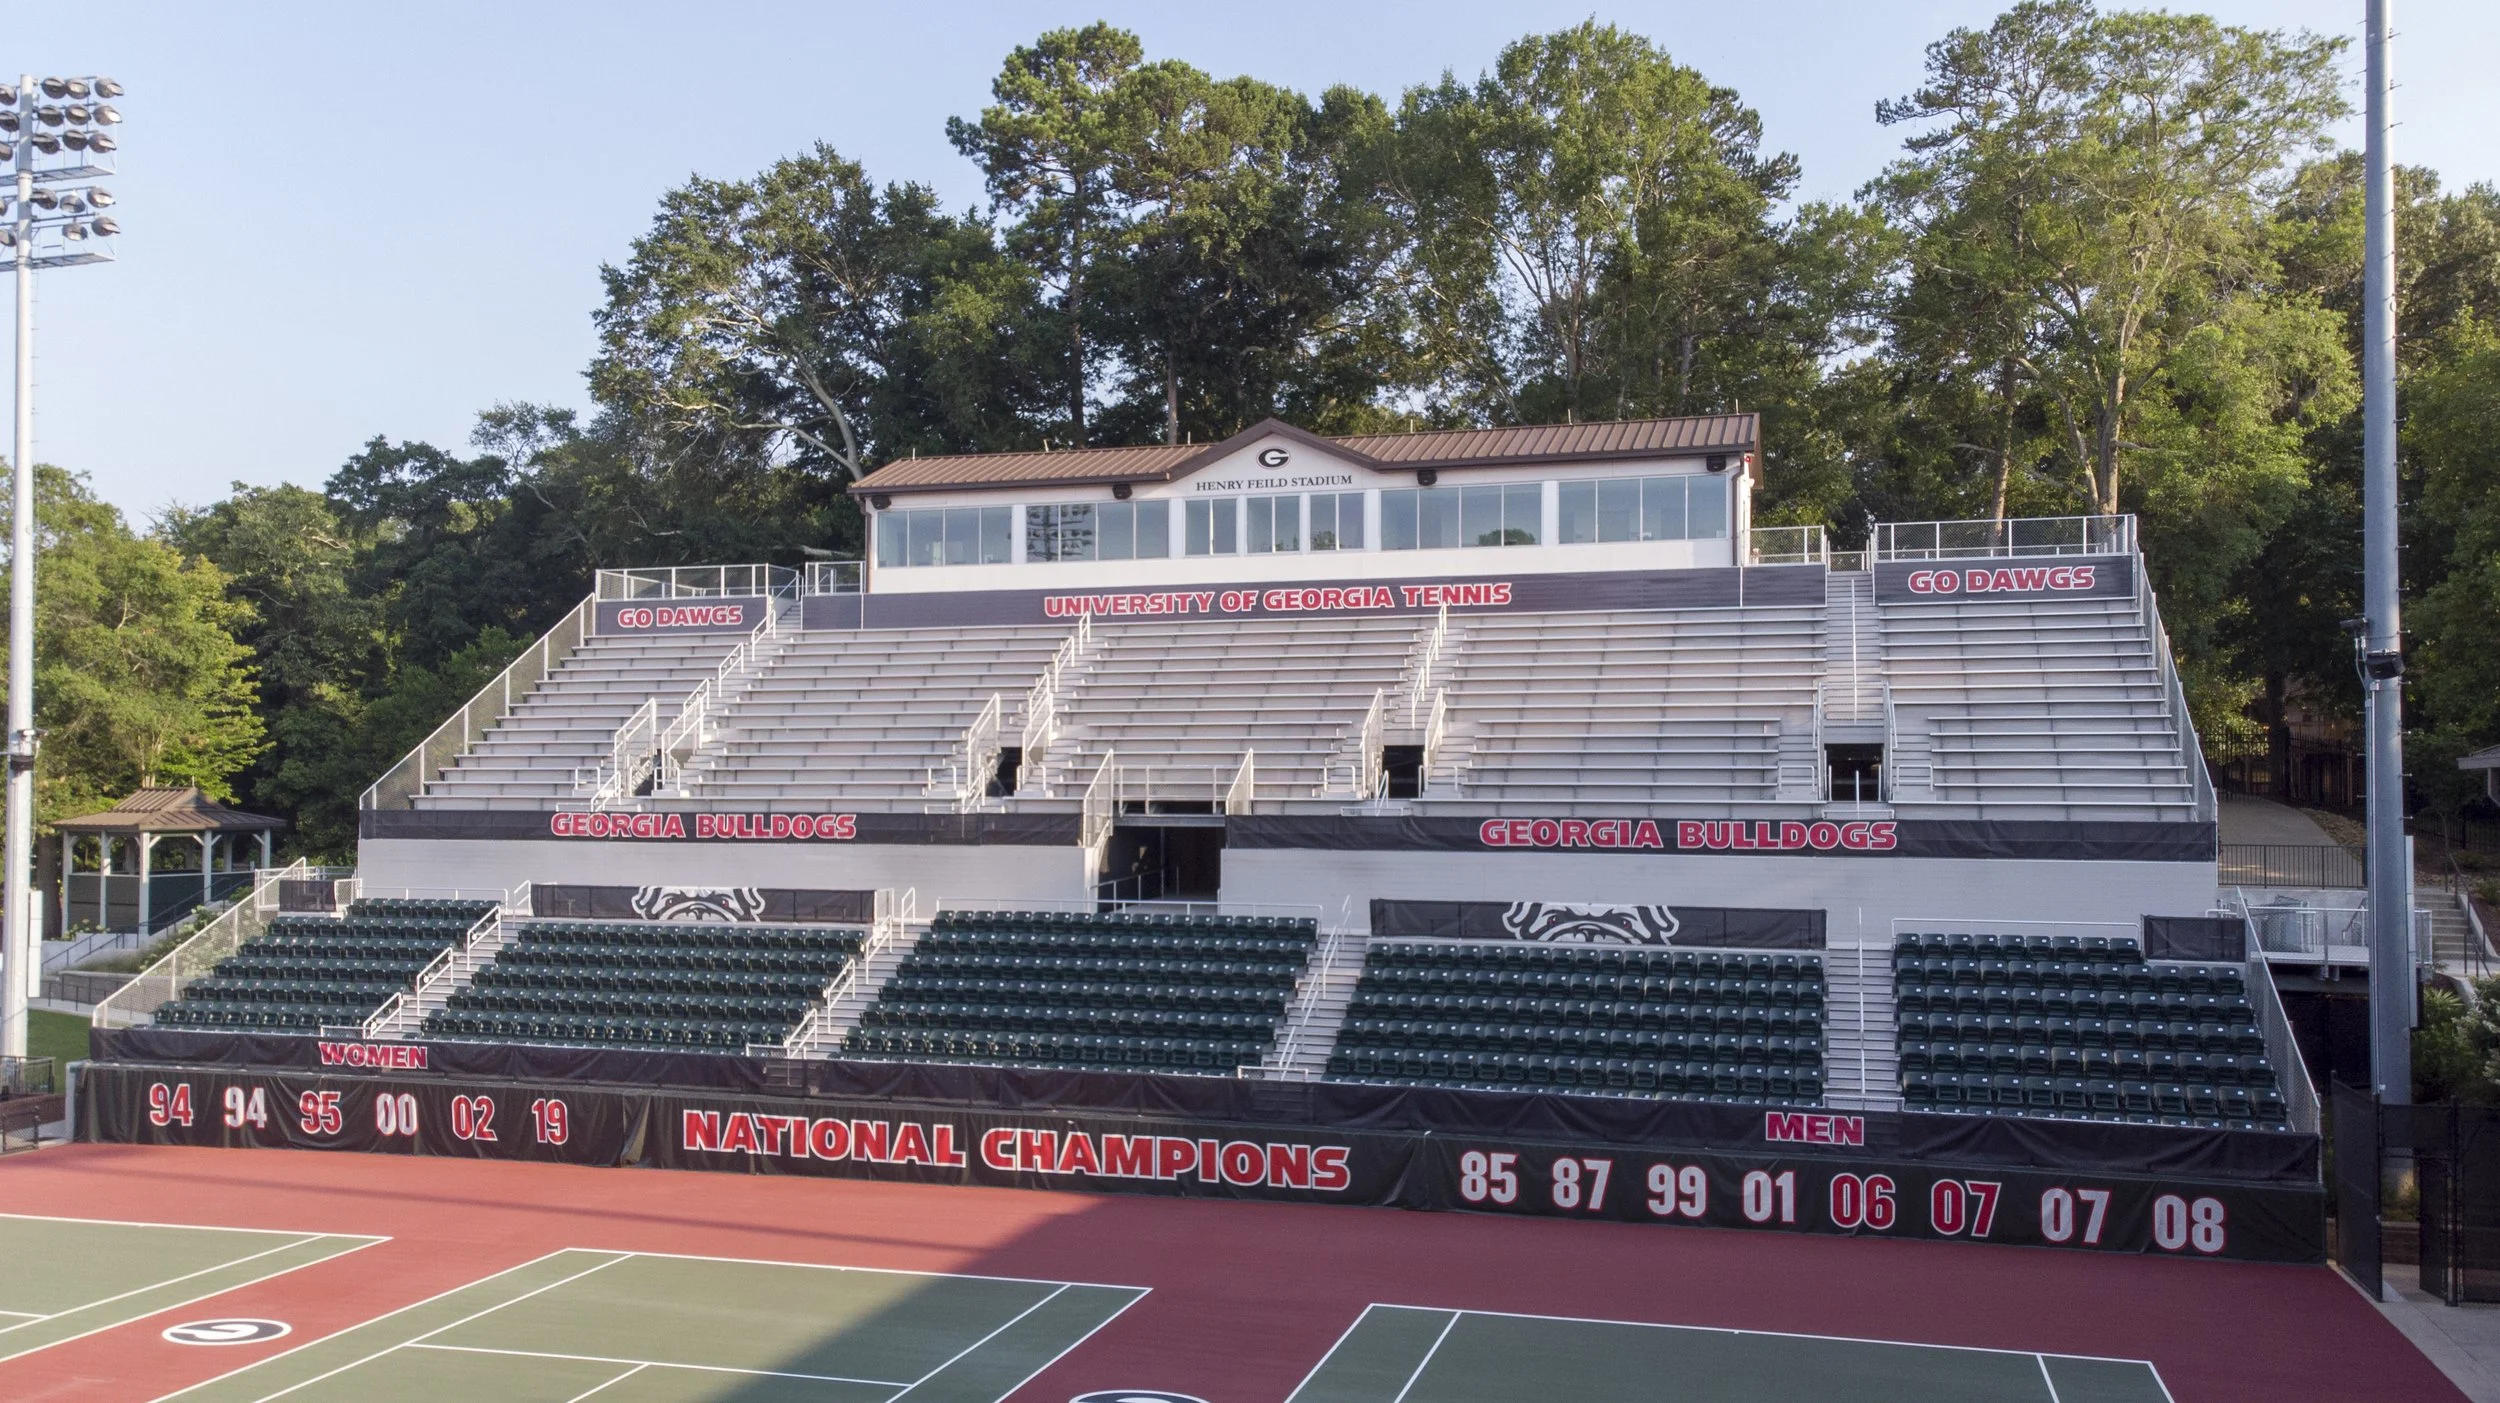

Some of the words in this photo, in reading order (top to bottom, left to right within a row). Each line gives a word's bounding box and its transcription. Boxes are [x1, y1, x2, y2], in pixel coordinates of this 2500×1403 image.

[1257, 448, 1289, 468] G
[1196, 480, 1243, 491] HENRY
[1247, 478, 1287, 489] FEILD
[1291, 475, 1352, 487] STADIUM
[1908, 570, 1959, 594] GO
[1966, 566, 2095, 592] DAWGS
[1045, 591, 1215, 618] UNIVERSITY
[1220, 590, 1257, 612] OF
[1263, 586, 1395, 611] GEORGIA
[1400, 583, 1512, 607] TENNIS
[618, 608, 653, 628] GO
[656, 605, 743, 627] DAWGS
[551, 812, 686, 838] GEORGIA
[696, 814, 857, 840] BULLDOGS
[1479, 818, 1664, 848] GEORGIA
[1677, 820, 1898, 850] BULLDOGS
[318, 1041, 428, 1070] WOMEN
[149, 1083, 193, 1127] 94
[223, 1087, 268, 1129] 94
[299, 1090, 343, 1135] 95
[375, 1093, 419, 1136] 00
[451, 1095, 498, 1142] 02
[532, 1099, 569, 1145] 19
[1765, 1111, 1865, 1147] MEN
[682, 1109, 967, 1169] NATIONAL
[980, 1126, 1352, 1191] CHAMPIONS
[1459, 1150, 1519, 1205] 85
[1551, 1157, 1613, 1211] 87
[1647, 1163, 1707, 1218] 99
[1741, 1169, 1797, 1223] 01
[1829, 1172, 1896, 1230] 06
[1930, 1178, 2002, 1238] 07
[2040, 1186, 2112, 1245] 07
[2152, 1194, 2227, 1254] 08
